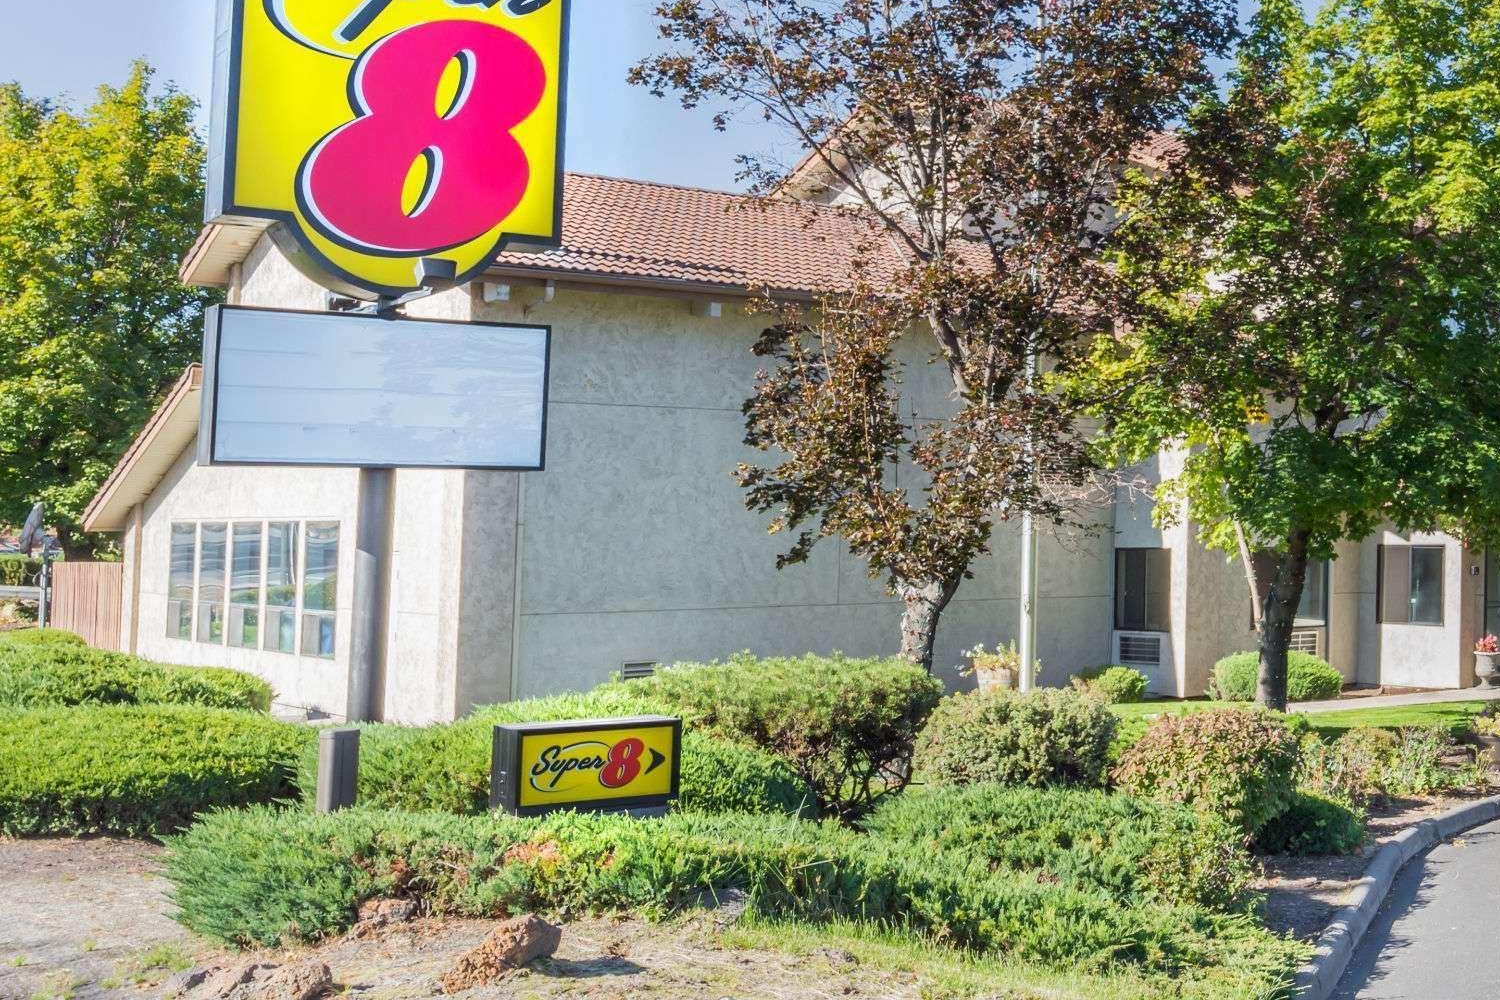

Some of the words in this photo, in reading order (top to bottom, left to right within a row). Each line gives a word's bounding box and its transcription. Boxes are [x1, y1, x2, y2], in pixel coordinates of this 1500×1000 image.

[294, 19, 547, 258] 8
[531, 745, 606, 788] Super
[599, 737, 645, 789] 8
